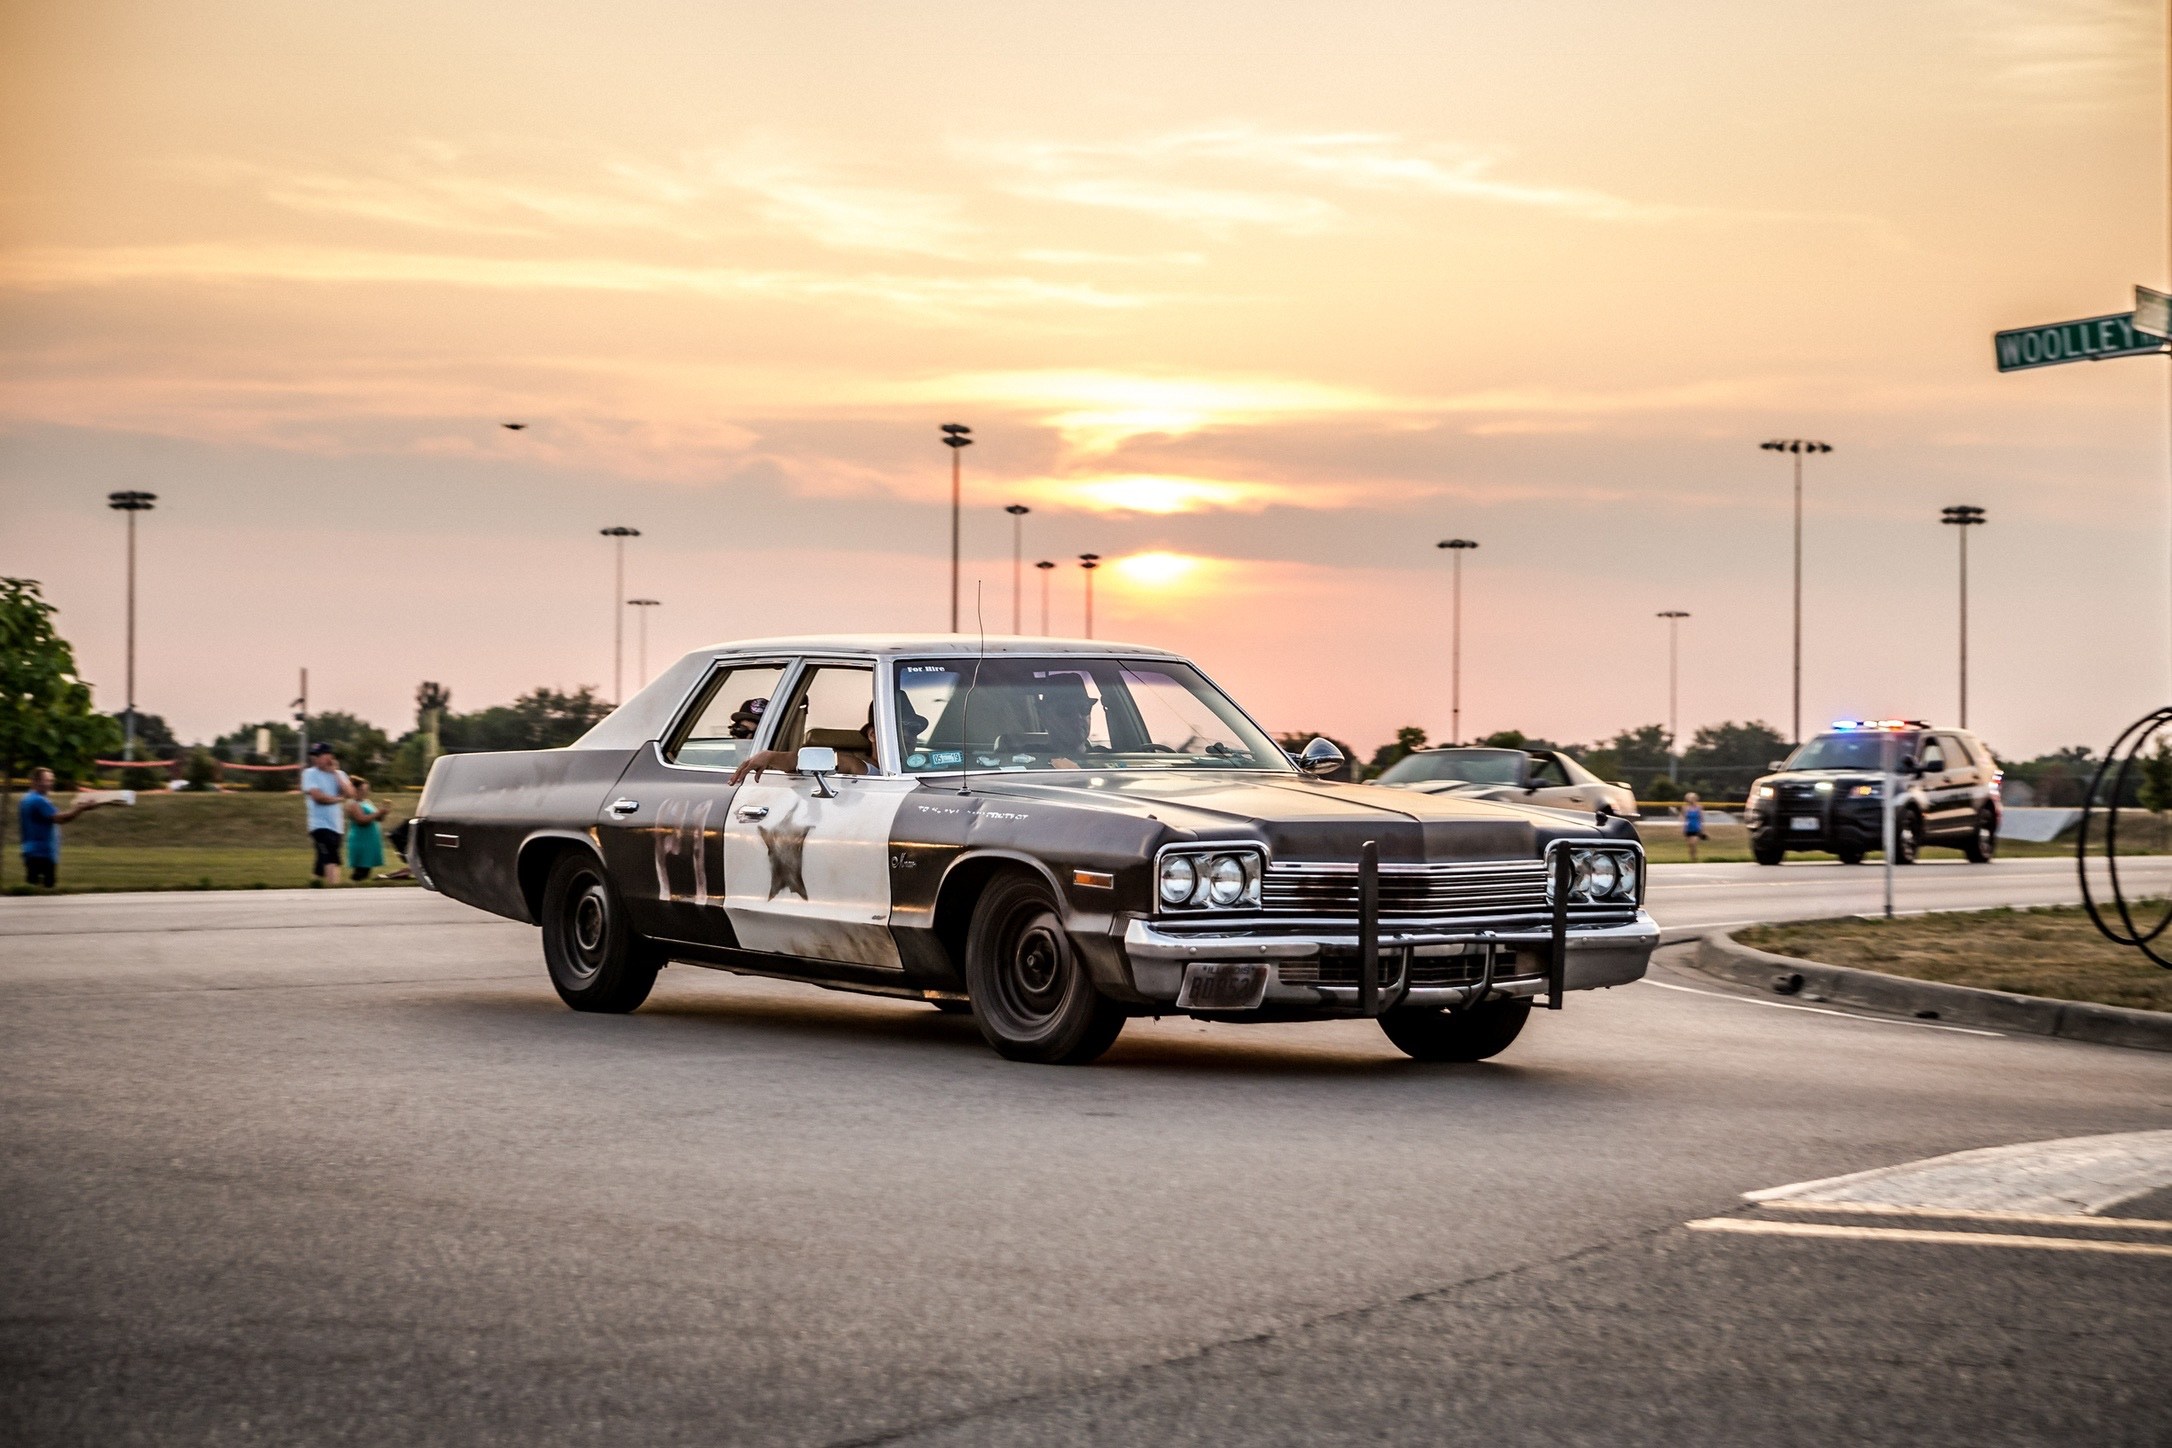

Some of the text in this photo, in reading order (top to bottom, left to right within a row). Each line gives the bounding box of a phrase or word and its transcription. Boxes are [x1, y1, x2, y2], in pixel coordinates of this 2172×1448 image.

[2001, 319, 2134, 366] WOOLLEY
[1207, 966, 1250, 975] ILLOIS
[1189, 976, 1261, 999] BDR52
